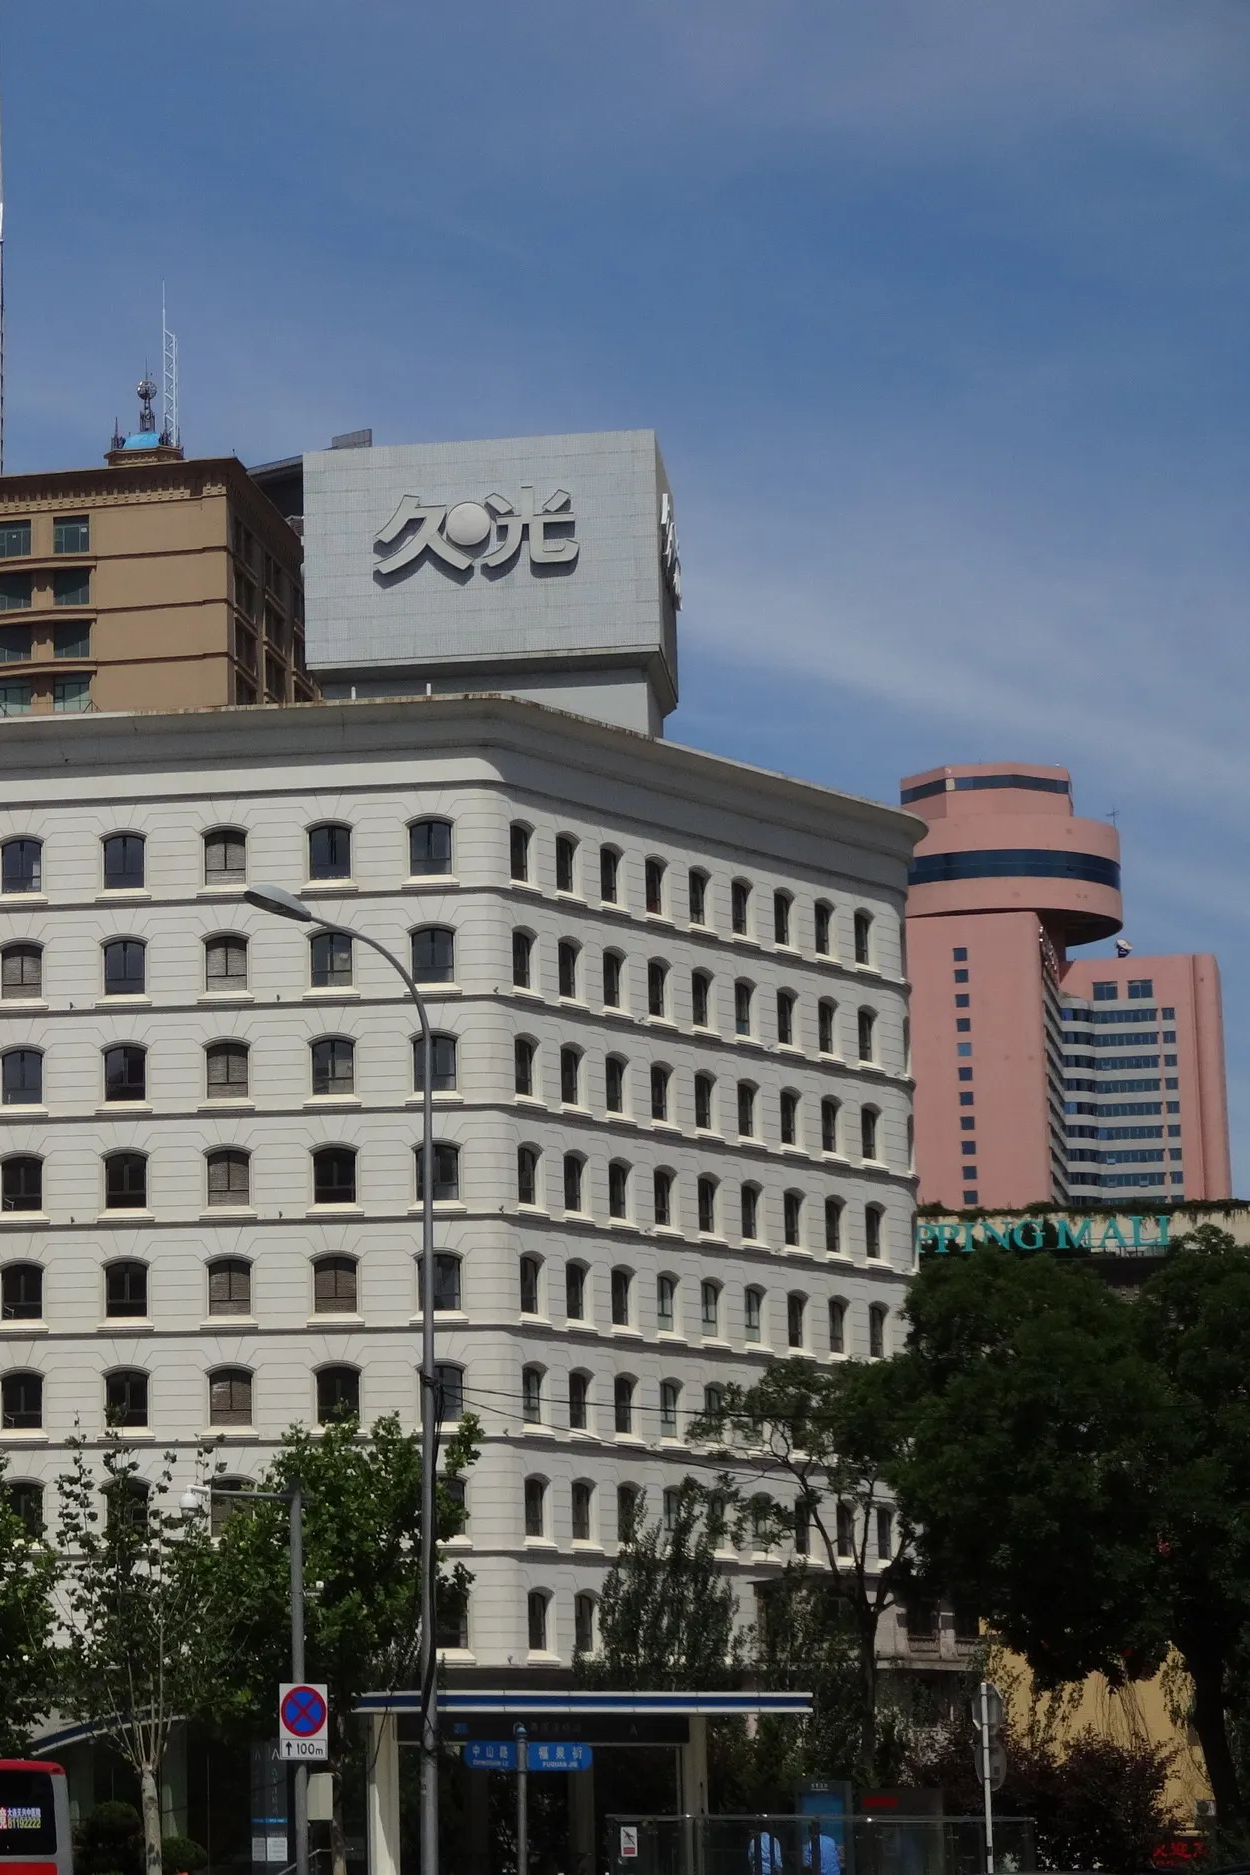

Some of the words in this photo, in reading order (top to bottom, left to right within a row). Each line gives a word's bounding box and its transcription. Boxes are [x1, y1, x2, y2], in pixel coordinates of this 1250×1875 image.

[296, 1743, 324, 1755] 100m
[472, 1744, 509, 1759] 中山路
